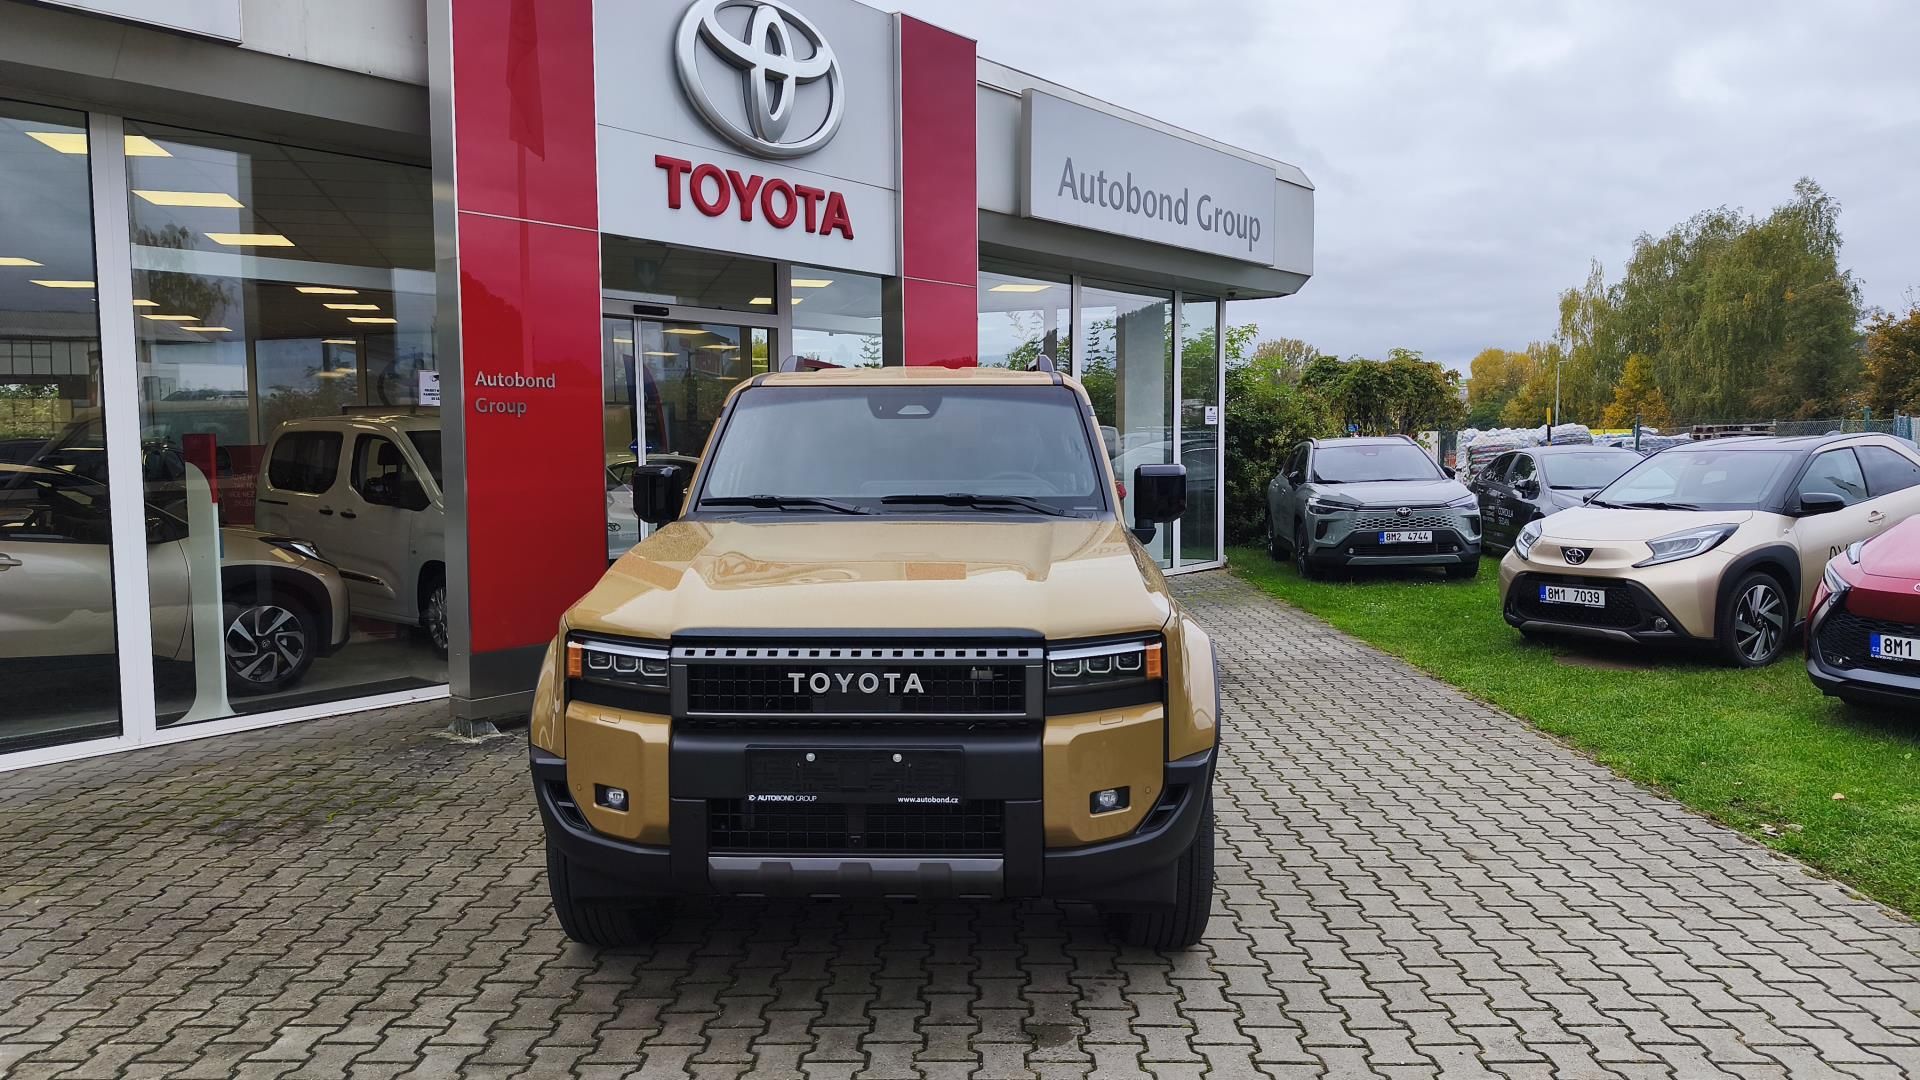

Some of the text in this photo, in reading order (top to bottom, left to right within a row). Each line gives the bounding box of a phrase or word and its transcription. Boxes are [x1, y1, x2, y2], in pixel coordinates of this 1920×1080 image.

[655, 154, 854, 240] TOYOTA
[1057, 156, 1261, 252] Autobond Group
[474, 370, 556, 389] Autobond
[475, 397, 527, 418] Group
[1385, 532, 1401, 541] 8M2
[1407, 532, 1428, 541] 4744
[1548, 588, 1600, 604] 8M1 7039
[1884, 638, 1912, 657] 8M1
[787, 672, 925, 694] TOYOTA
[757, 794, 795, 802] AUTOBOND
[897, 795, 959, 804] www.autobond.cz
